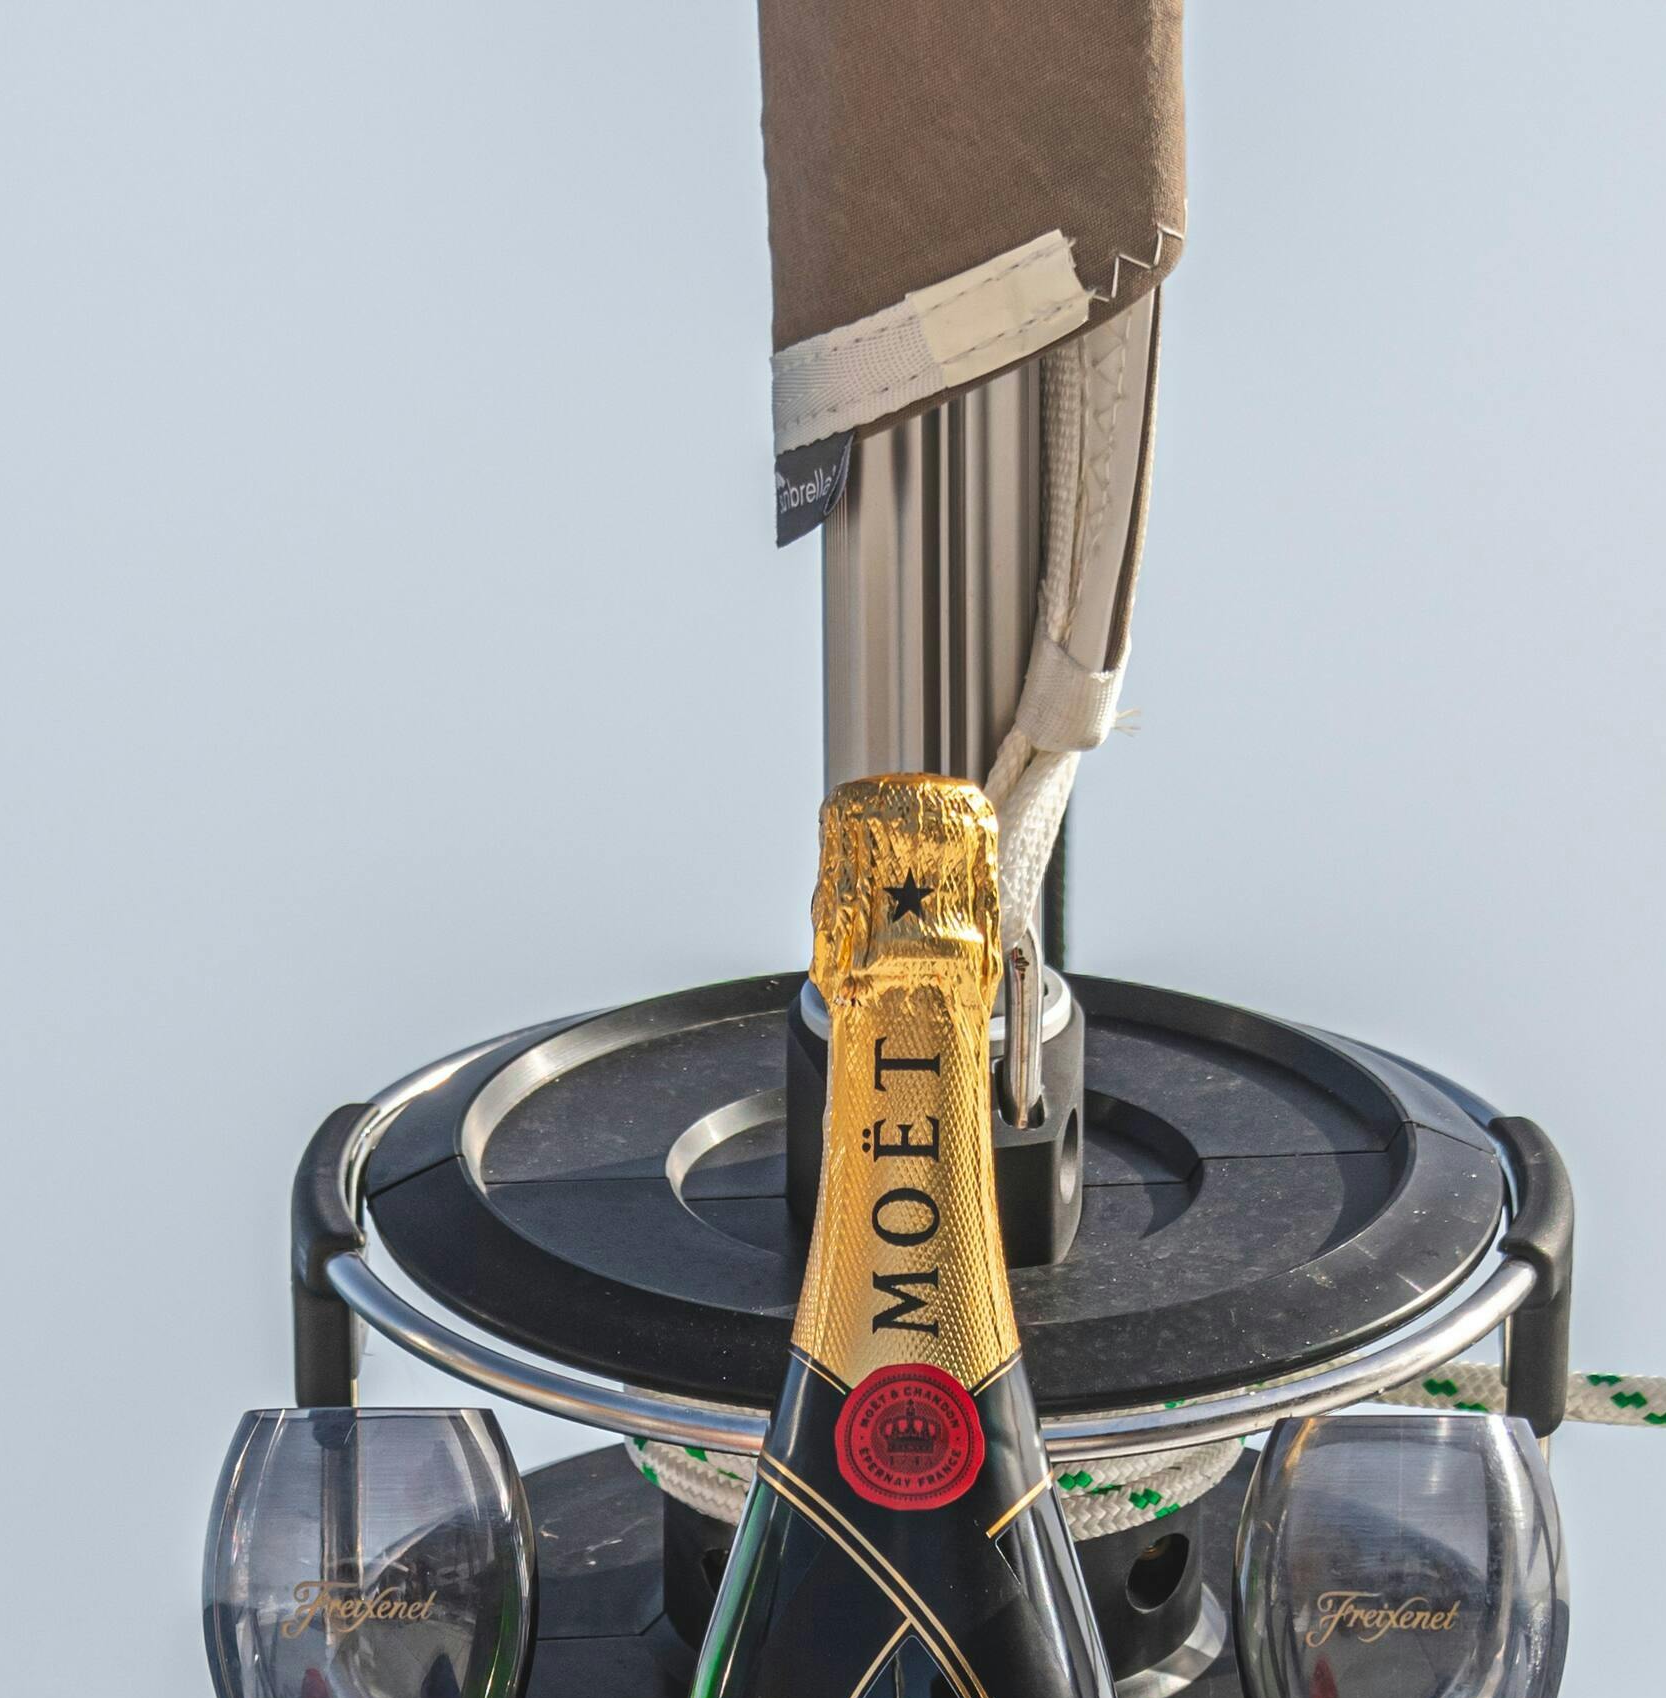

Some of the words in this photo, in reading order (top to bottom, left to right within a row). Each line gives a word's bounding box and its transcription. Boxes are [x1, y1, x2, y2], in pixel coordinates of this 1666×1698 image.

[861, 1036, 941, 1337] MOËT
[904, 1387, 960, 1428] CHANDON
[918, 1449, 962, 1487] FRANCE
[281, 1581, 438, 1639] Freixenet
[1305, 1590, 1461, 1648] Freixenet
